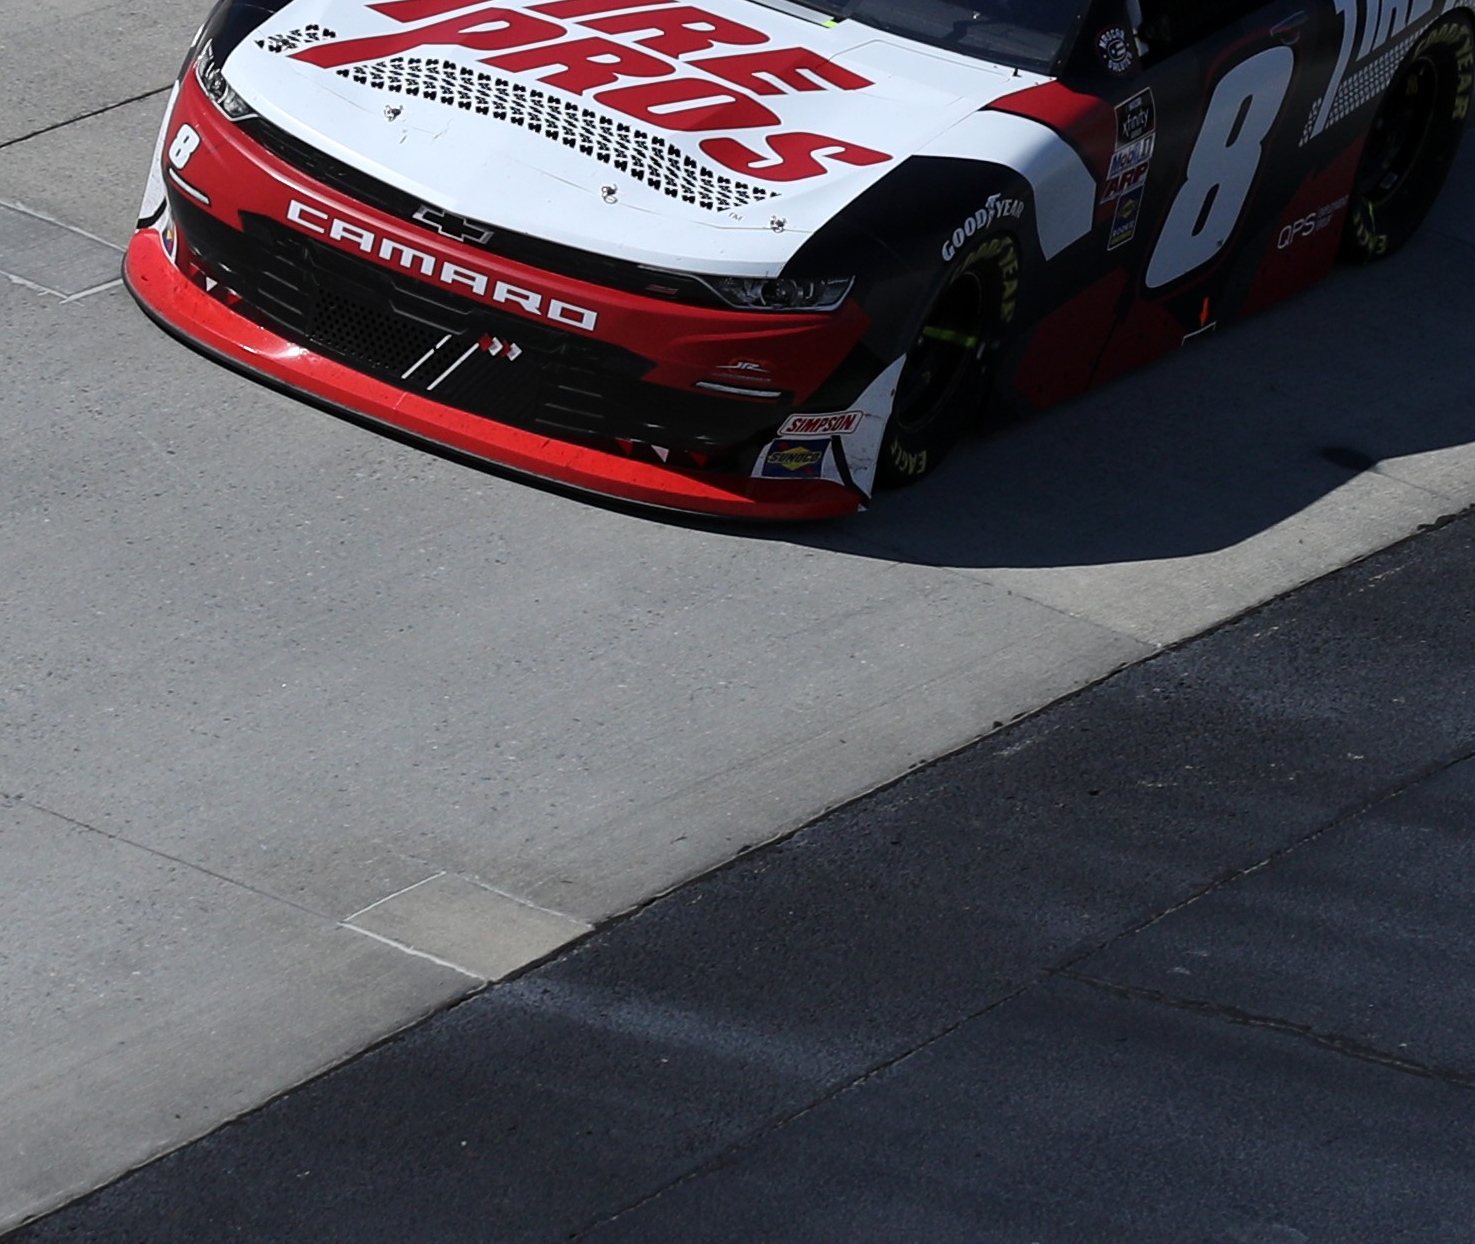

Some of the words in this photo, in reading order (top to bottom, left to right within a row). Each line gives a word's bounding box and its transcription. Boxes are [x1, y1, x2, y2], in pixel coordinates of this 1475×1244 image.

[287, 7, 894, 182] PROS
[1122, 107, 1151, 139] xfinity
[169, 123, 201, 170] 8
[1145, 45, 1295, 288] 8
[1105, 162, 1149, 199] ARP
[941, 193, 1025, 263] GOODYEAR
[1277, 212, 1316, 250] QPS
[286, 200, 599, 332] CAMARO
[787, 413, 857, 433] SIMPSON
[766, 451, 823, 464] SUNOCO
